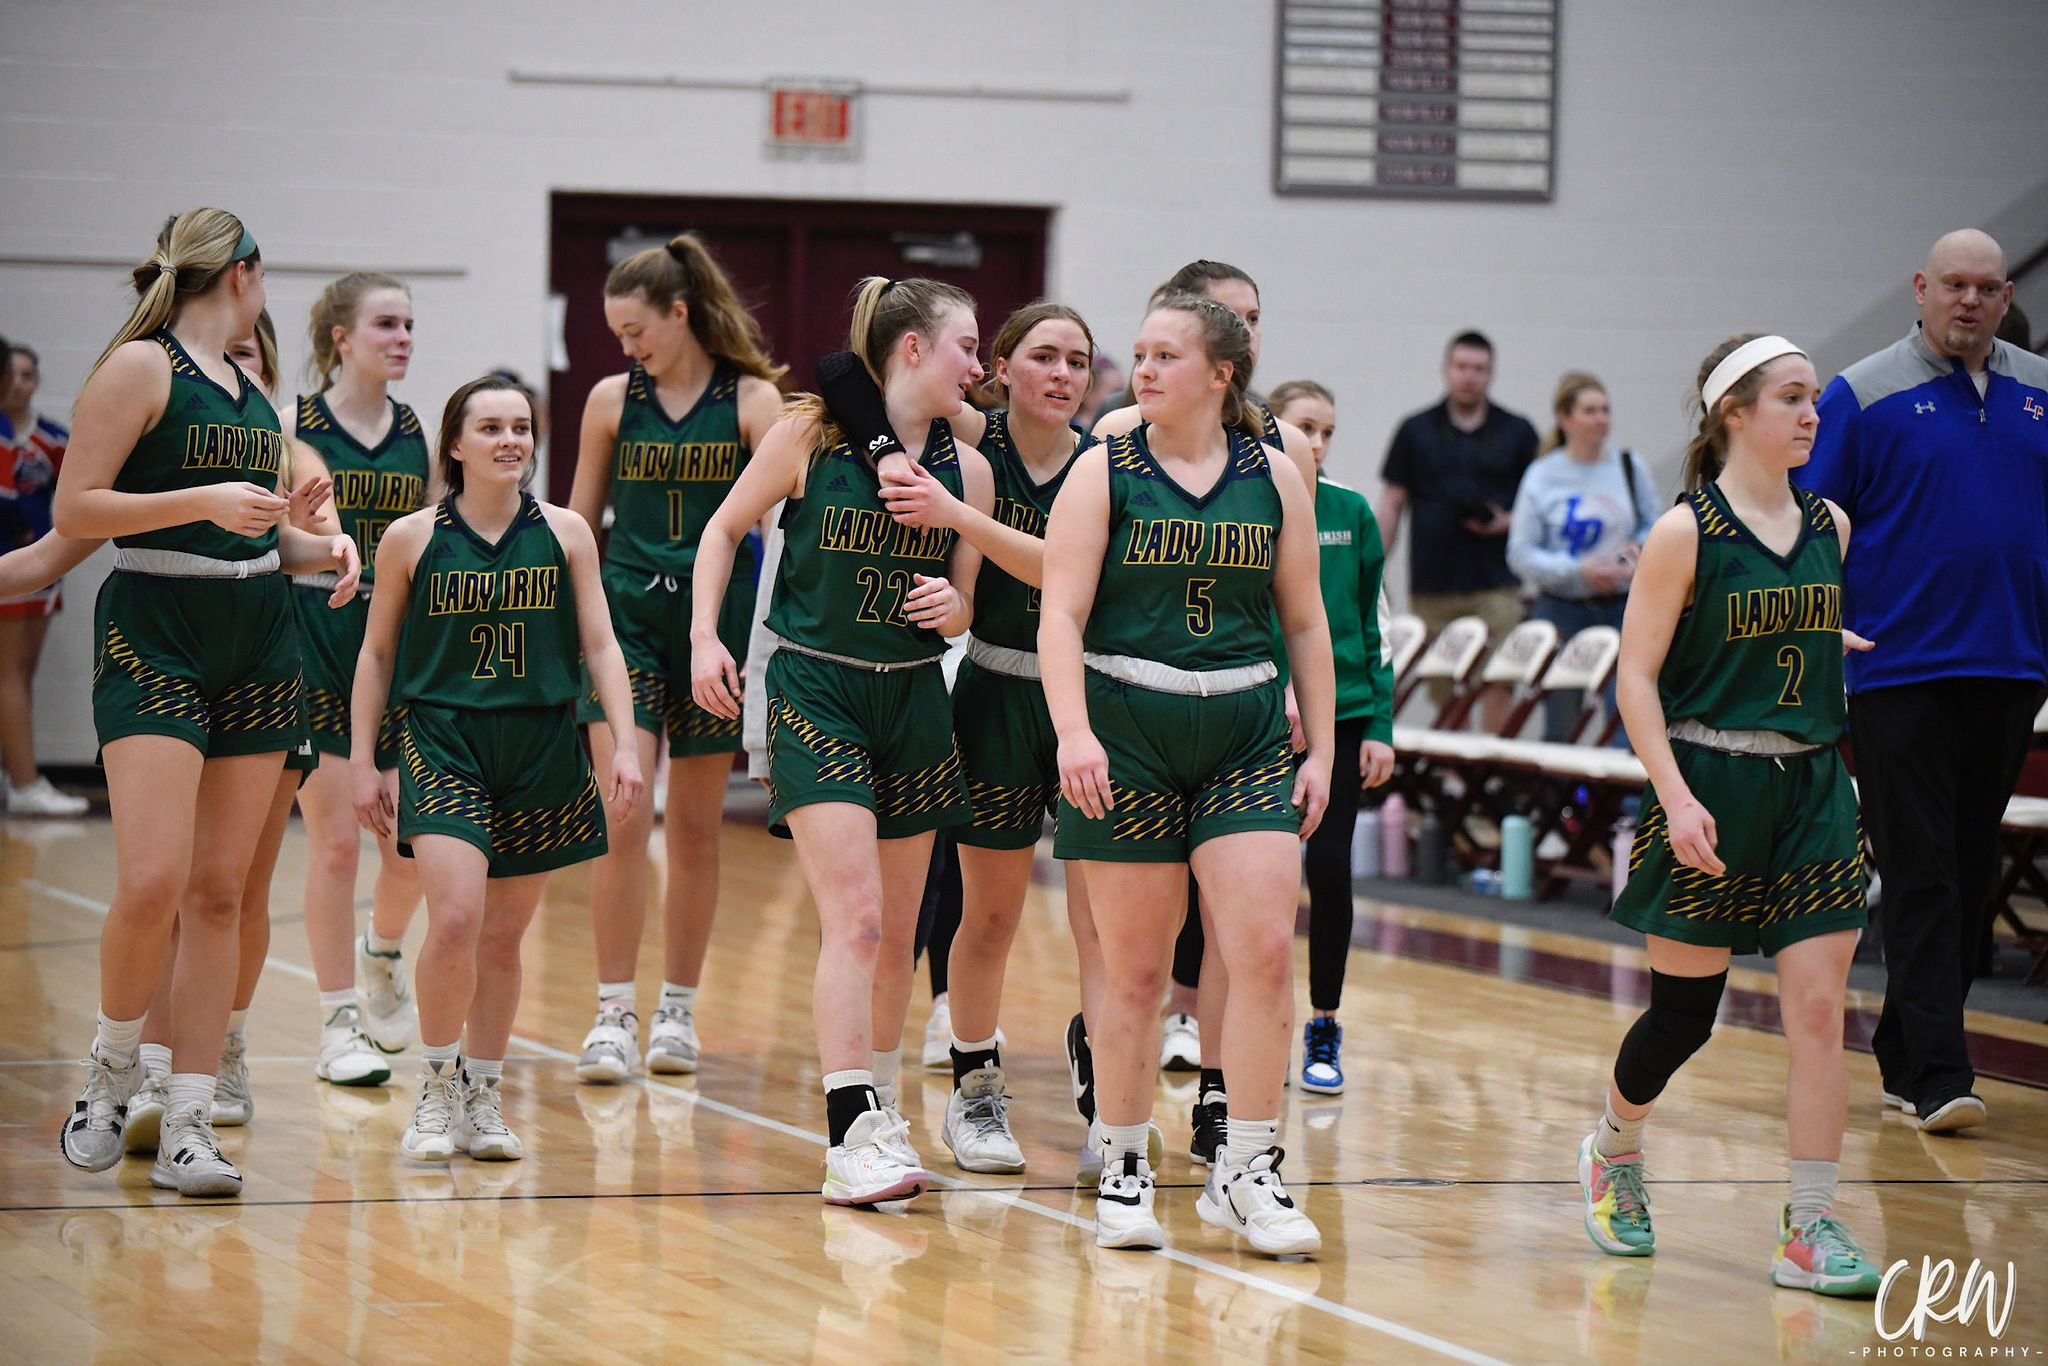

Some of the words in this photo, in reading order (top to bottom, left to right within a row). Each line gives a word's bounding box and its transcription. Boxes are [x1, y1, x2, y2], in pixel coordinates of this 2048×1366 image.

[2023, 396, 2044, 420] LP
[182, 424, 248, 469] LADY
[618, 442, 675, 481] LADY
[675, 442, 738, 481] IRISH
[333, 470, 375, 509] ADY
[667, 489, 682, 540] 1
[819, 506, 893, 555] LADY
[1122, 519, 1205, 565] LADY
[1206, 522, 1273, 570] IRISH
[428, 571, 497, 616] LADY
[498, 566, 559, 611] IRISH
[856, 566, 910, 627] 22
[1186, 578, 1217, 637] 5
[1725, 587, 1796, 642] LADY
[470, 622, 526, 679] 24
[1777, 645, 1804, 706] 2
